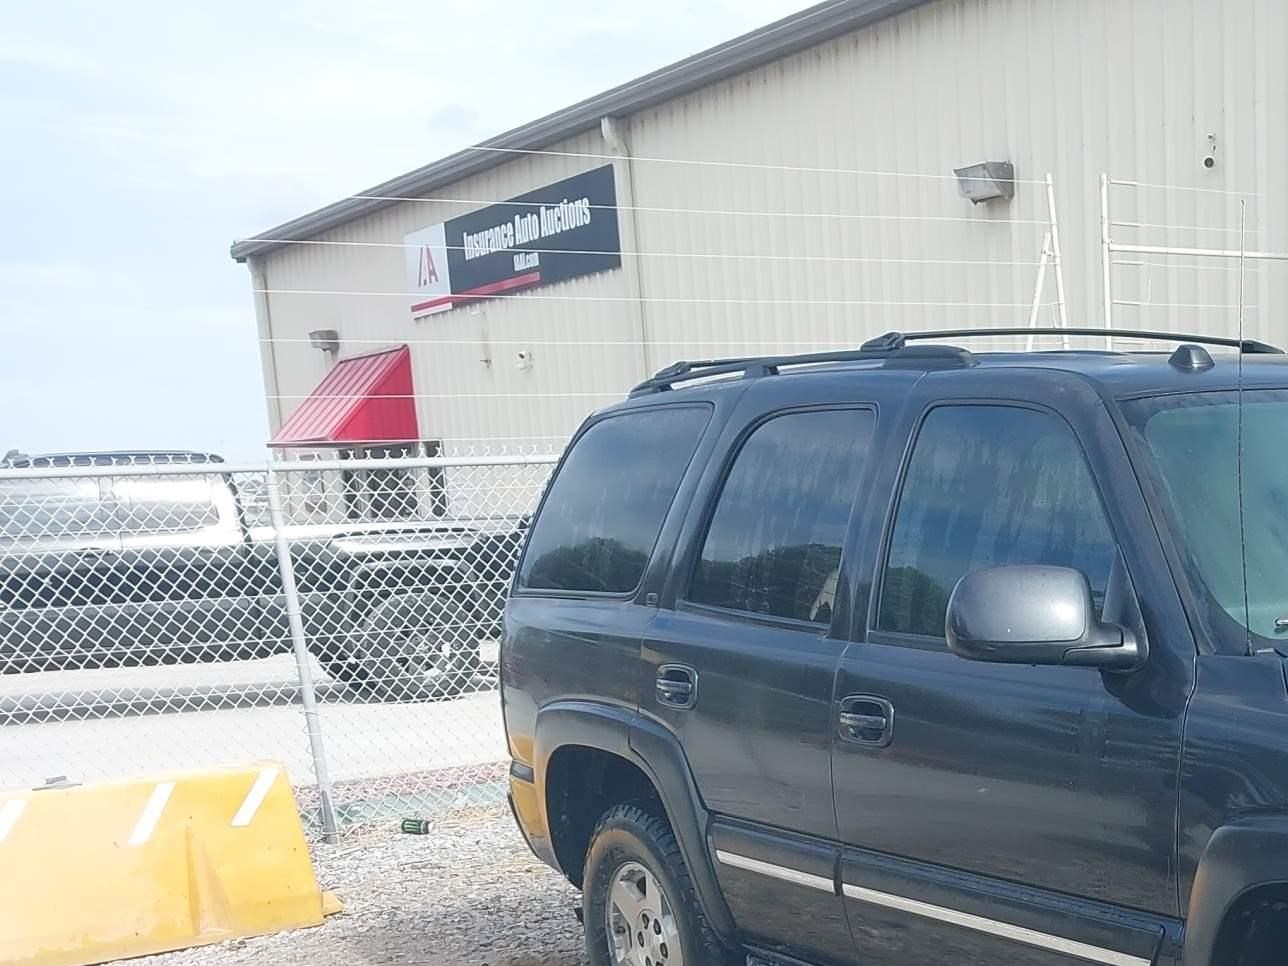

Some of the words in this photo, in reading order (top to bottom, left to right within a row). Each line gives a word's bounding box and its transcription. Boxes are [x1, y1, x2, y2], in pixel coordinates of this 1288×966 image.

[463, 221, 515, 261] Insurance
[514, 212, 539, 246] Auto
[540, 197, 591, 238] Auctions
